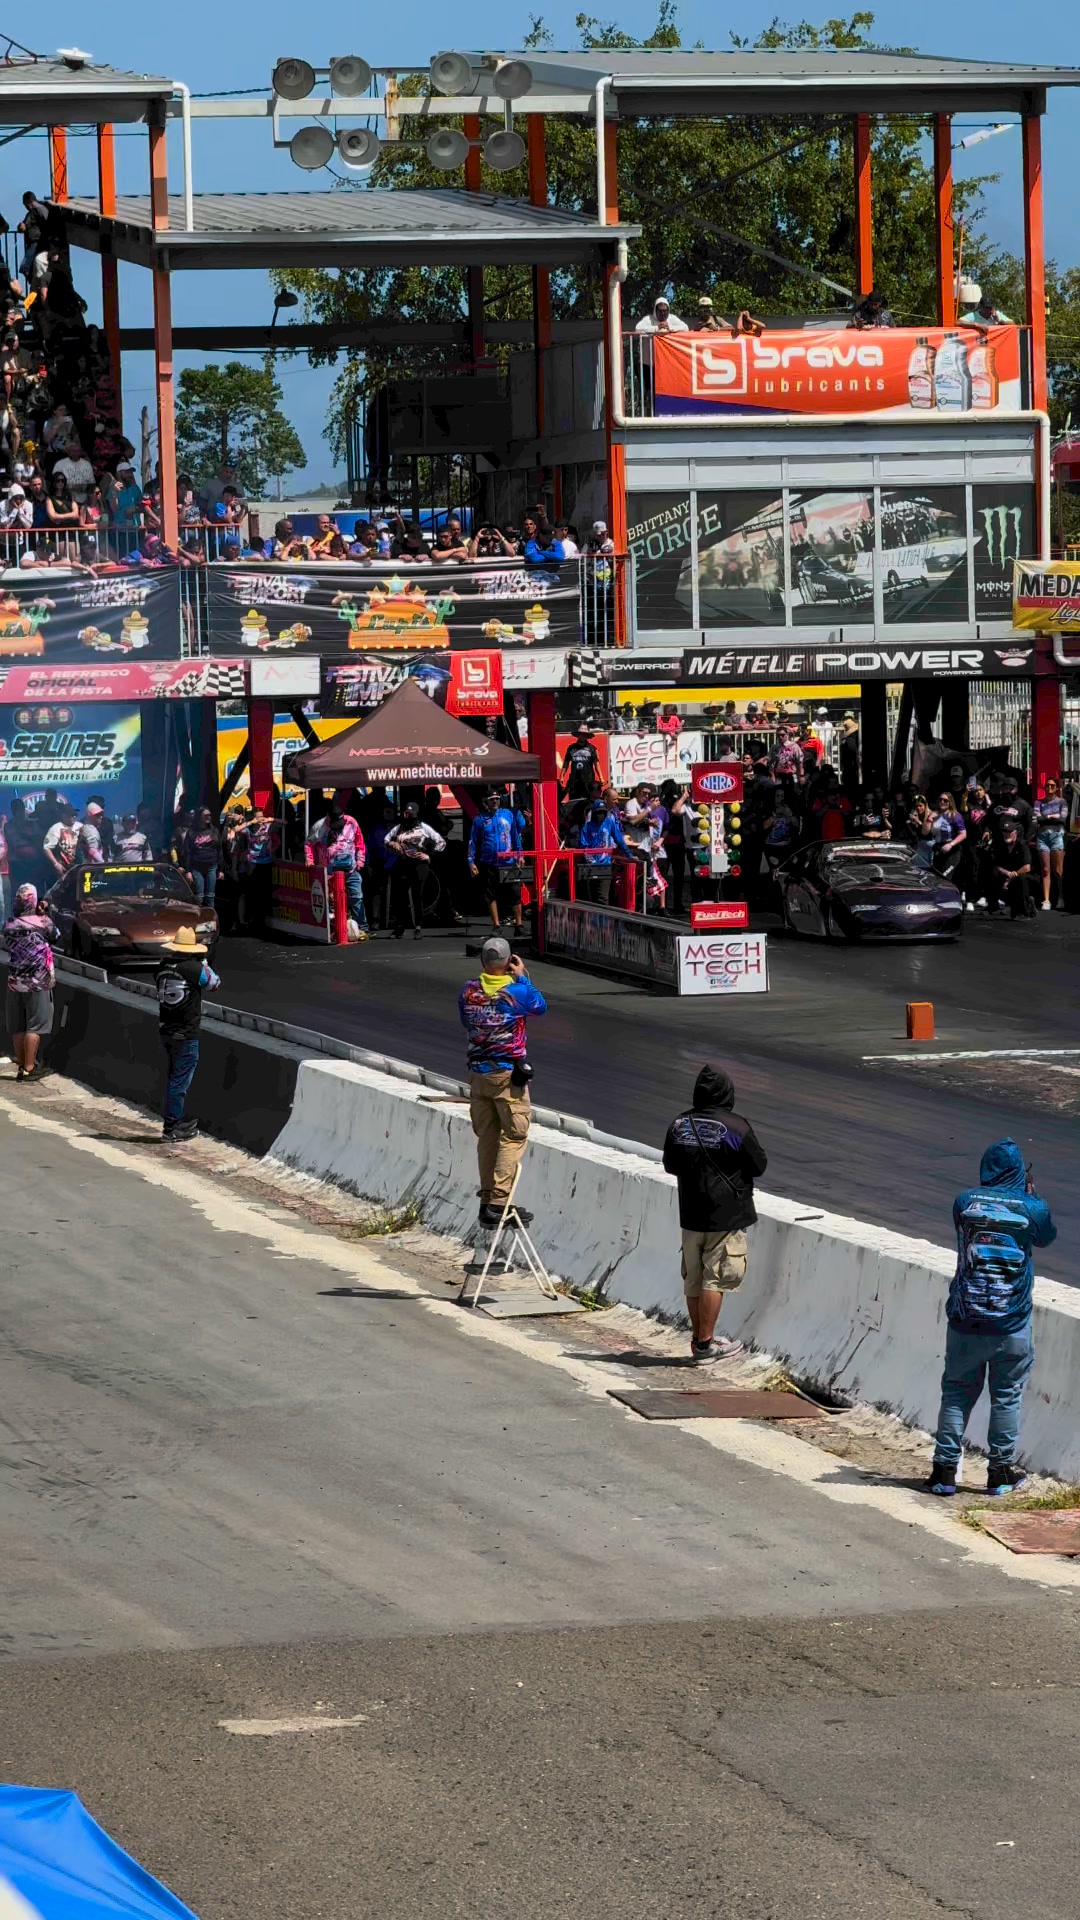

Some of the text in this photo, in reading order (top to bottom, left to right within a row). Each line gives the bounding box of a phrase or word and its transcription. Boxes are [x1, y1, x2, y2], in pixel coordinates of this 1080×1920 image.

[753, 339, 884, 369] brava
[754, 377, 886, 394] lubricants
[627, 500, 690, 541] BRITTANY
[628, 504, 722, 568] FORCE
[603, 662, 681, 671] POWERADE
[688, 650, 984, 676] MÉTELE POWER
[29, 669, 131, 679] EL REFRESCO
[27, 678, 97, 688] OFICIAL
[346, 678, 440, 700] IMPT
[24, 687, 113, 697] DE LA PISTA
[456, 688, 498, 699] brava
[349, 746, 472, 757] MECH-TECH
[616, 739, 678, 759] MECH
[0, 759, 97, 770] SPEEDWAY
[367, 763, 483, 780] www.mechtech.edu
[616, 754, 678, 774] TECH
[47, 773, 120, 781] PROFESIALES
[703, 775, 733, 790] NHRA
[694, 910, 746, 921] FuelTech
[685, 942, 761, 959] MECH
[685, 959, 761, 976] TECH
